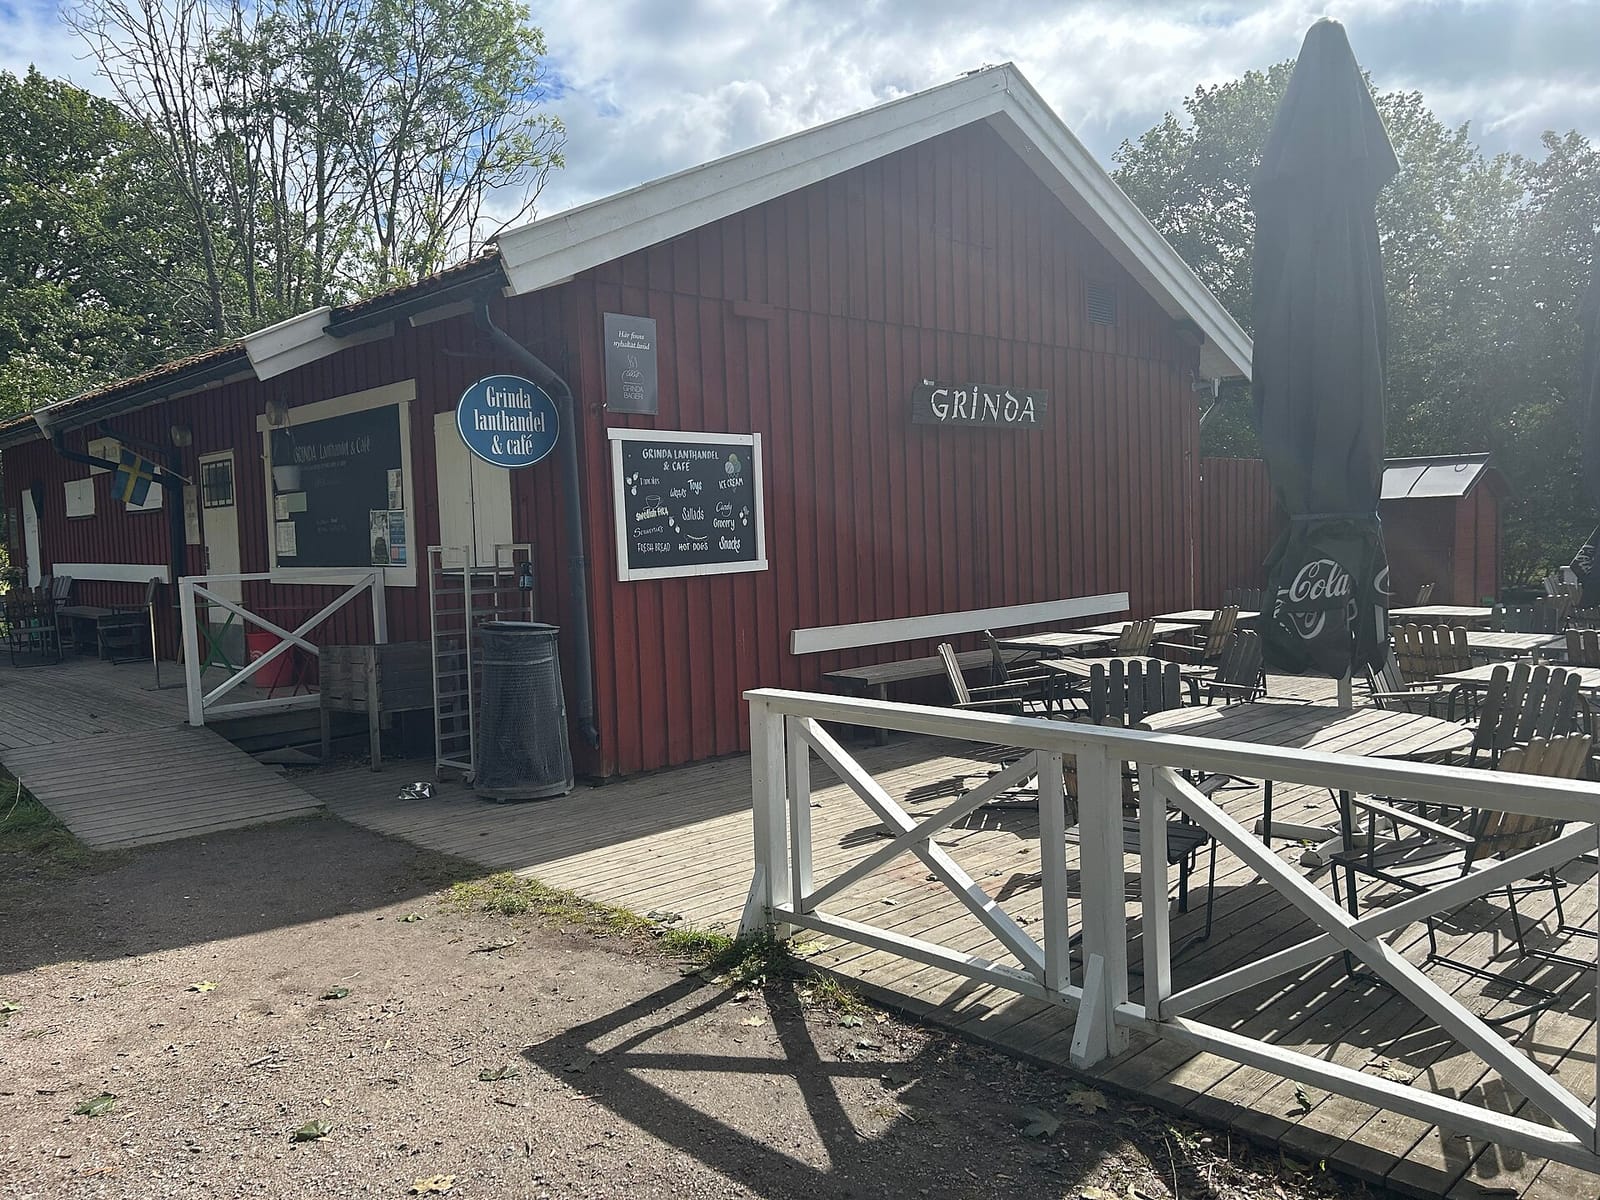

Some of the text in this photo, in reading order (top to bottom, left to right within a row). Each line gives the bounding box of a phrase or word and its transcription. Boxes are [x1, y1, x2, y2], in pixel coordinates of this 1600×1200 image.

[622, 384, 645, 393] GRINDA
[486, 385, 532, 409] Grinda
[931, 386, 1036, 422] GRINDA
[473, 408, 545, 433] lanthandel
[491, 433, 533, 456] & café
[642, 448, 720, 461] GRINDA LANTHANDEL
[663, 461, 670, 471] &
[687, 478, 703, 495] Toys
[718, 477, 744, 490] ICE CREAM
[681, 506, 705, 521] Sallads
[715, 501, 733, 517] Candy
[713, 518, 735, 531] Grocery
[637, 542, 671, 554] FRESH BREAD
[678, 542, 709, 551] HOT DOGS
[718, 535, 741, 554] Snacks
